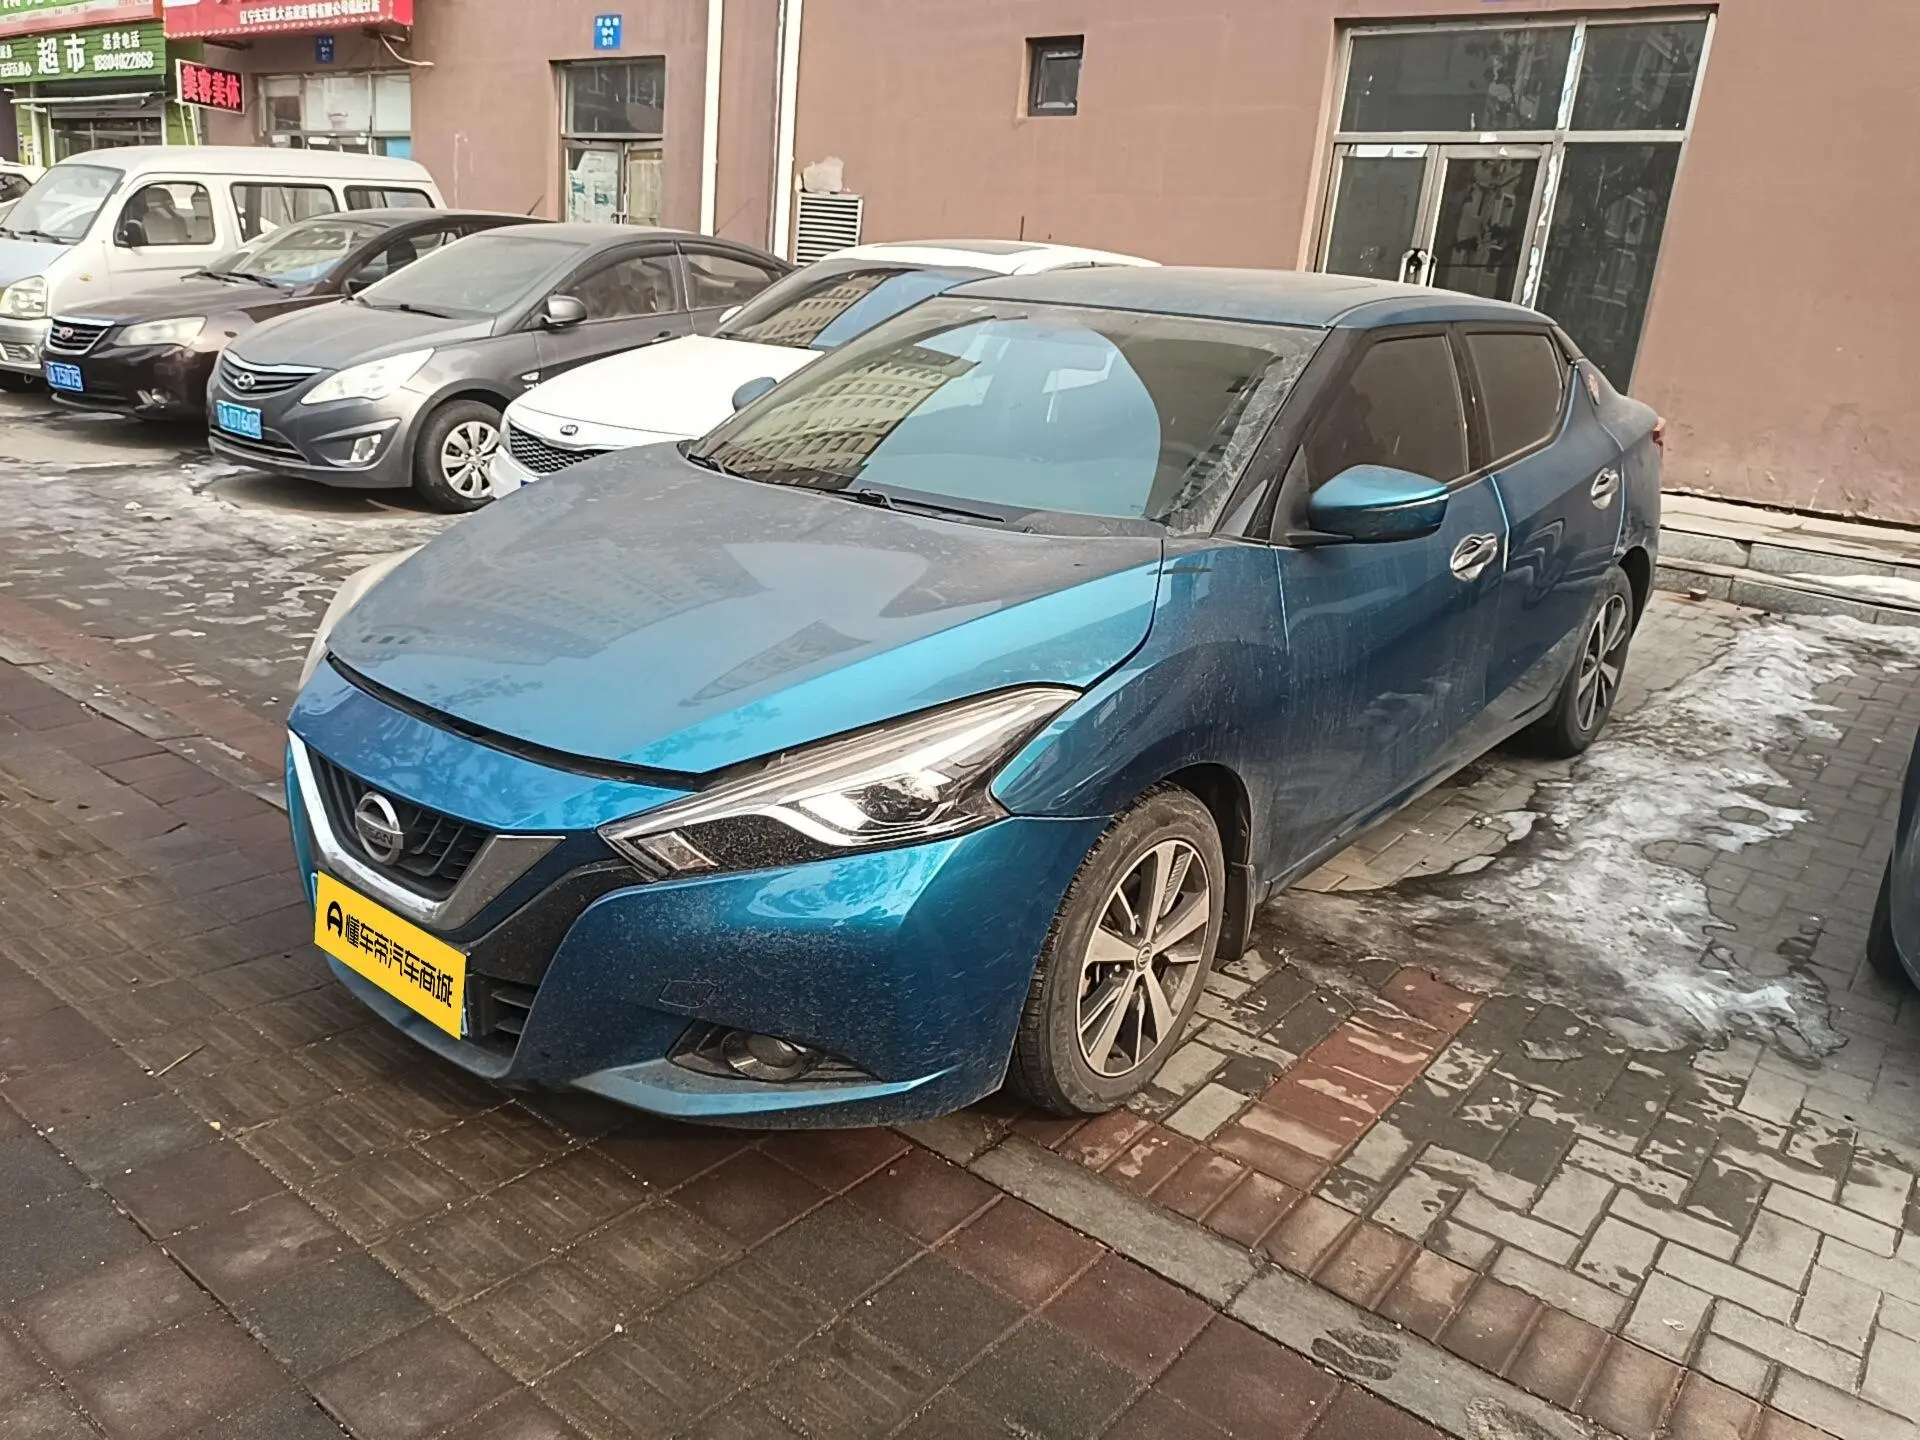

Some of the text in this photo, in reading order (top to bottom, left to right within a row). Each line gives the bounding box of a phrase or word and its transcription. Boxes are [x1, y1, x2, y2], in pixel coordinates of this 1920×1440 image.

[37, 33, 86, 75] 超市
[183, 65, 240, 109] 美容美体
